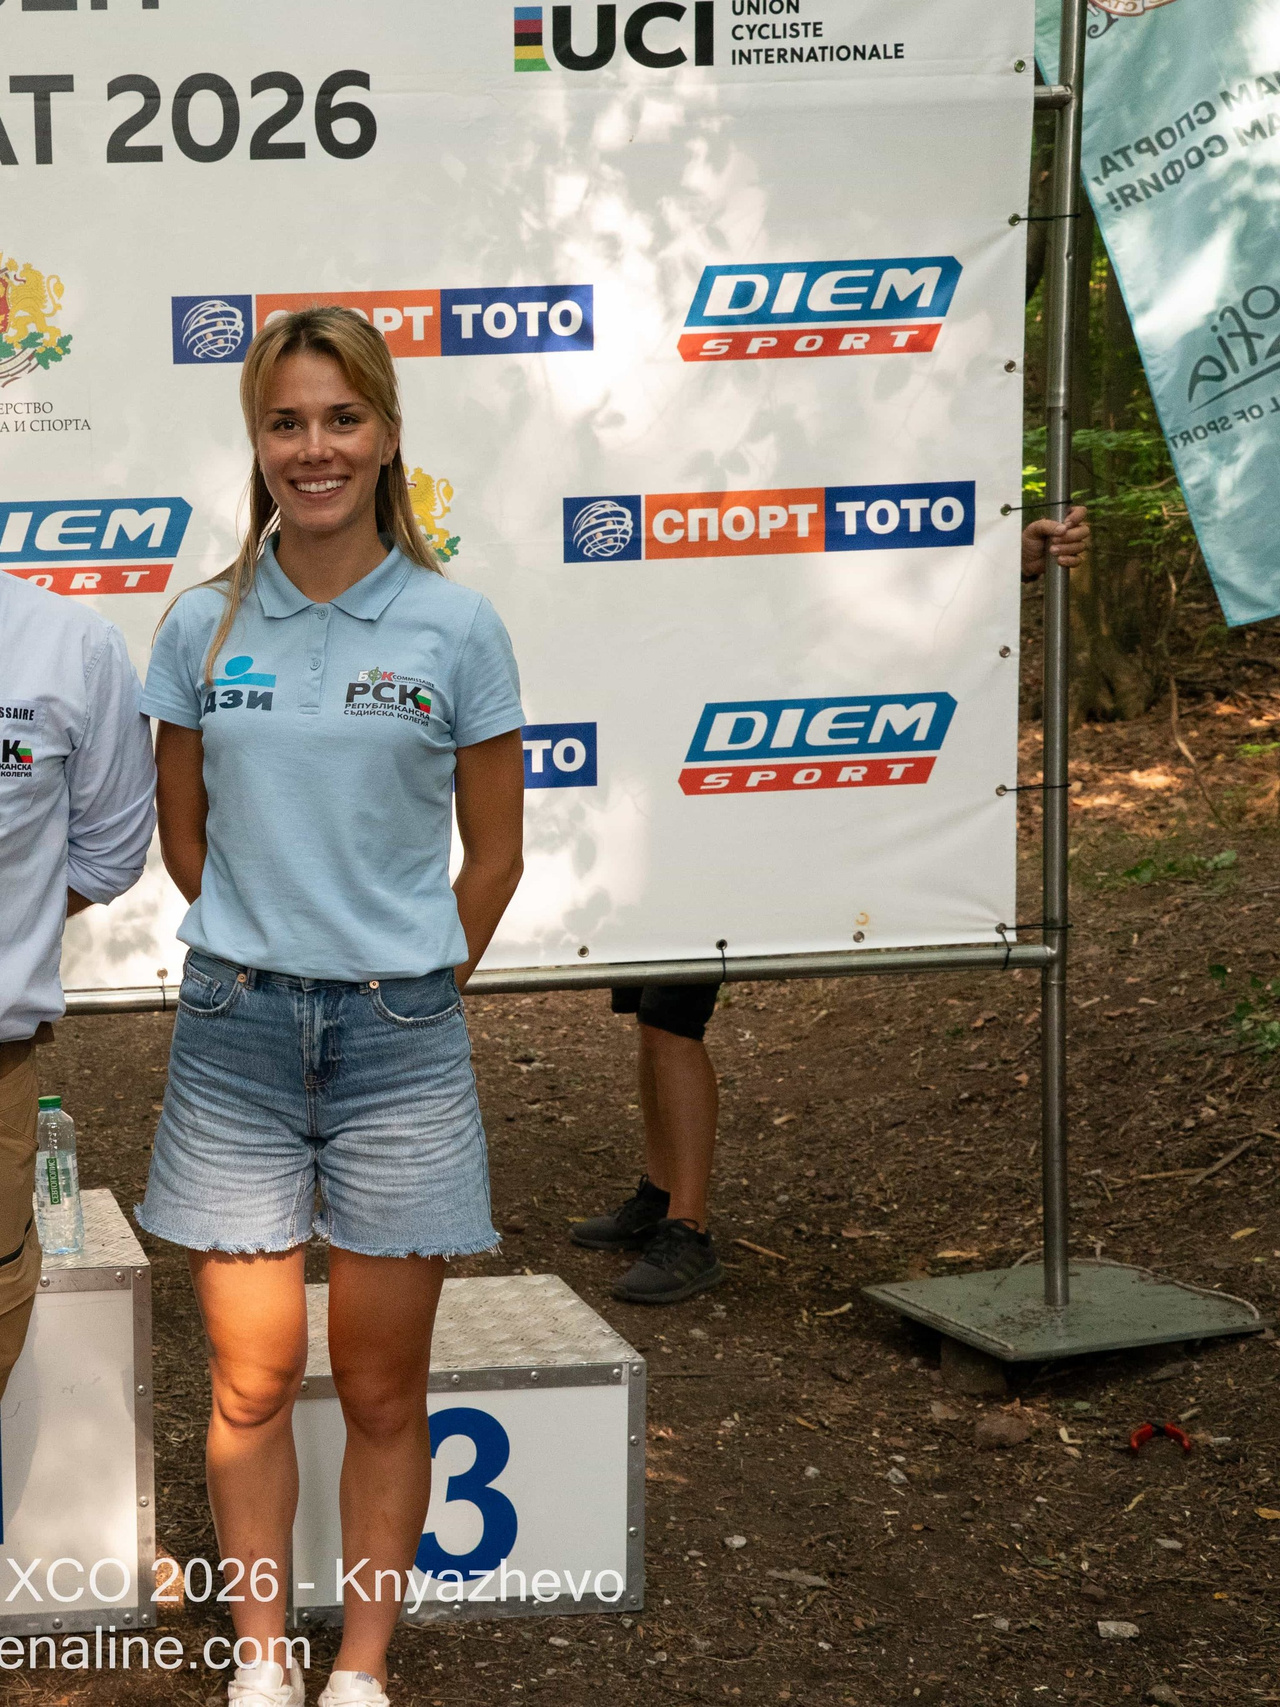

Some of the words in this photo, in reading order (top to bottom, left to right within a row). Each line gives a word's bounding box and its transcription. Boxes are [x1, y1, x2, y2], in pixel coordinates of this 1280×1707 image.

[732, 0, 800, 16] UNION
[552, 1, 714, 71] UCI
[732, 21, 823, 41] CYCLISTE
[732, 43, 905, 66] INTERNATIONALE
[106, 69, 377, 164] 2026
[701, 266, 942, 317] DIEM
[452, 299, 583, 339] ТОТО
[699, 329, 919, 356] SPORT
[14, 420, 27, 432] И
[30, 419, 91, 432] СПОРТА
[652, 503, 818, 544] СПОРТ
[836, 496, 965, 536] ТОТО
[203, 690, 273, 716] ДЗИ
[346, 682, 421, 710] РСК
[344, 709, 395, 718] СЪДИЙСКА
[345, 703, 430, 720] РЕПУБЛИКАНСКА
[702, 701, 942, 752] DIEM
[700, 763, 915, 790] SPORT
[413, 1407, 518, 1584] 3
